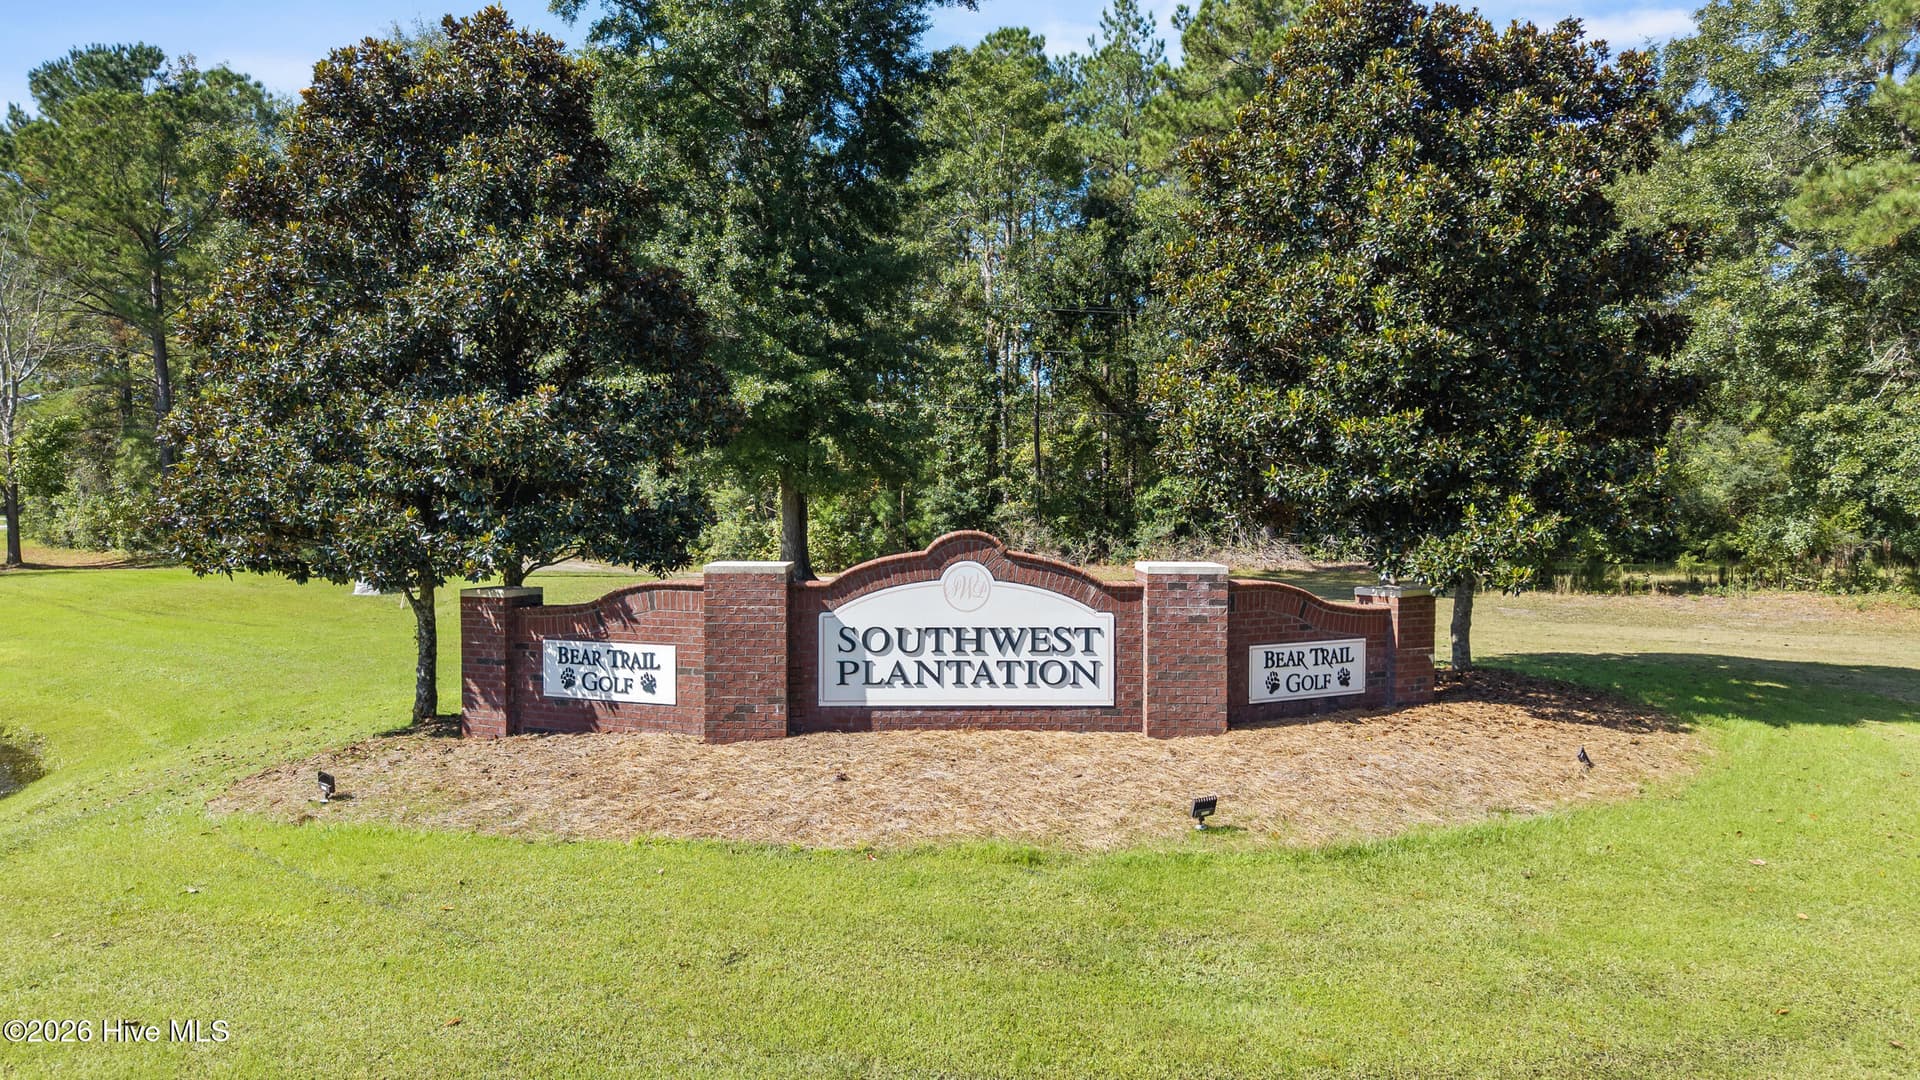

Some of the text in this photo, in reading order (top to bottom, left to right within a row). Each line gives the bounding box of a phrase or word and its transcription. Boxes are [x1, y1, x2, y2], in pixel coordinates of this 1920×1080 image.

[838, 626, 1103, 655] SOUTHWEST
[557, 646, 661, 673] BEAR TRAIL
[1264, 647, 1355, 670] BEAR TRAIL
[581, 671, 634, 694] GOLF
[836, 660, 1103, 688] PLANTATION
[1286, 673, 1331, 693] GOLF
